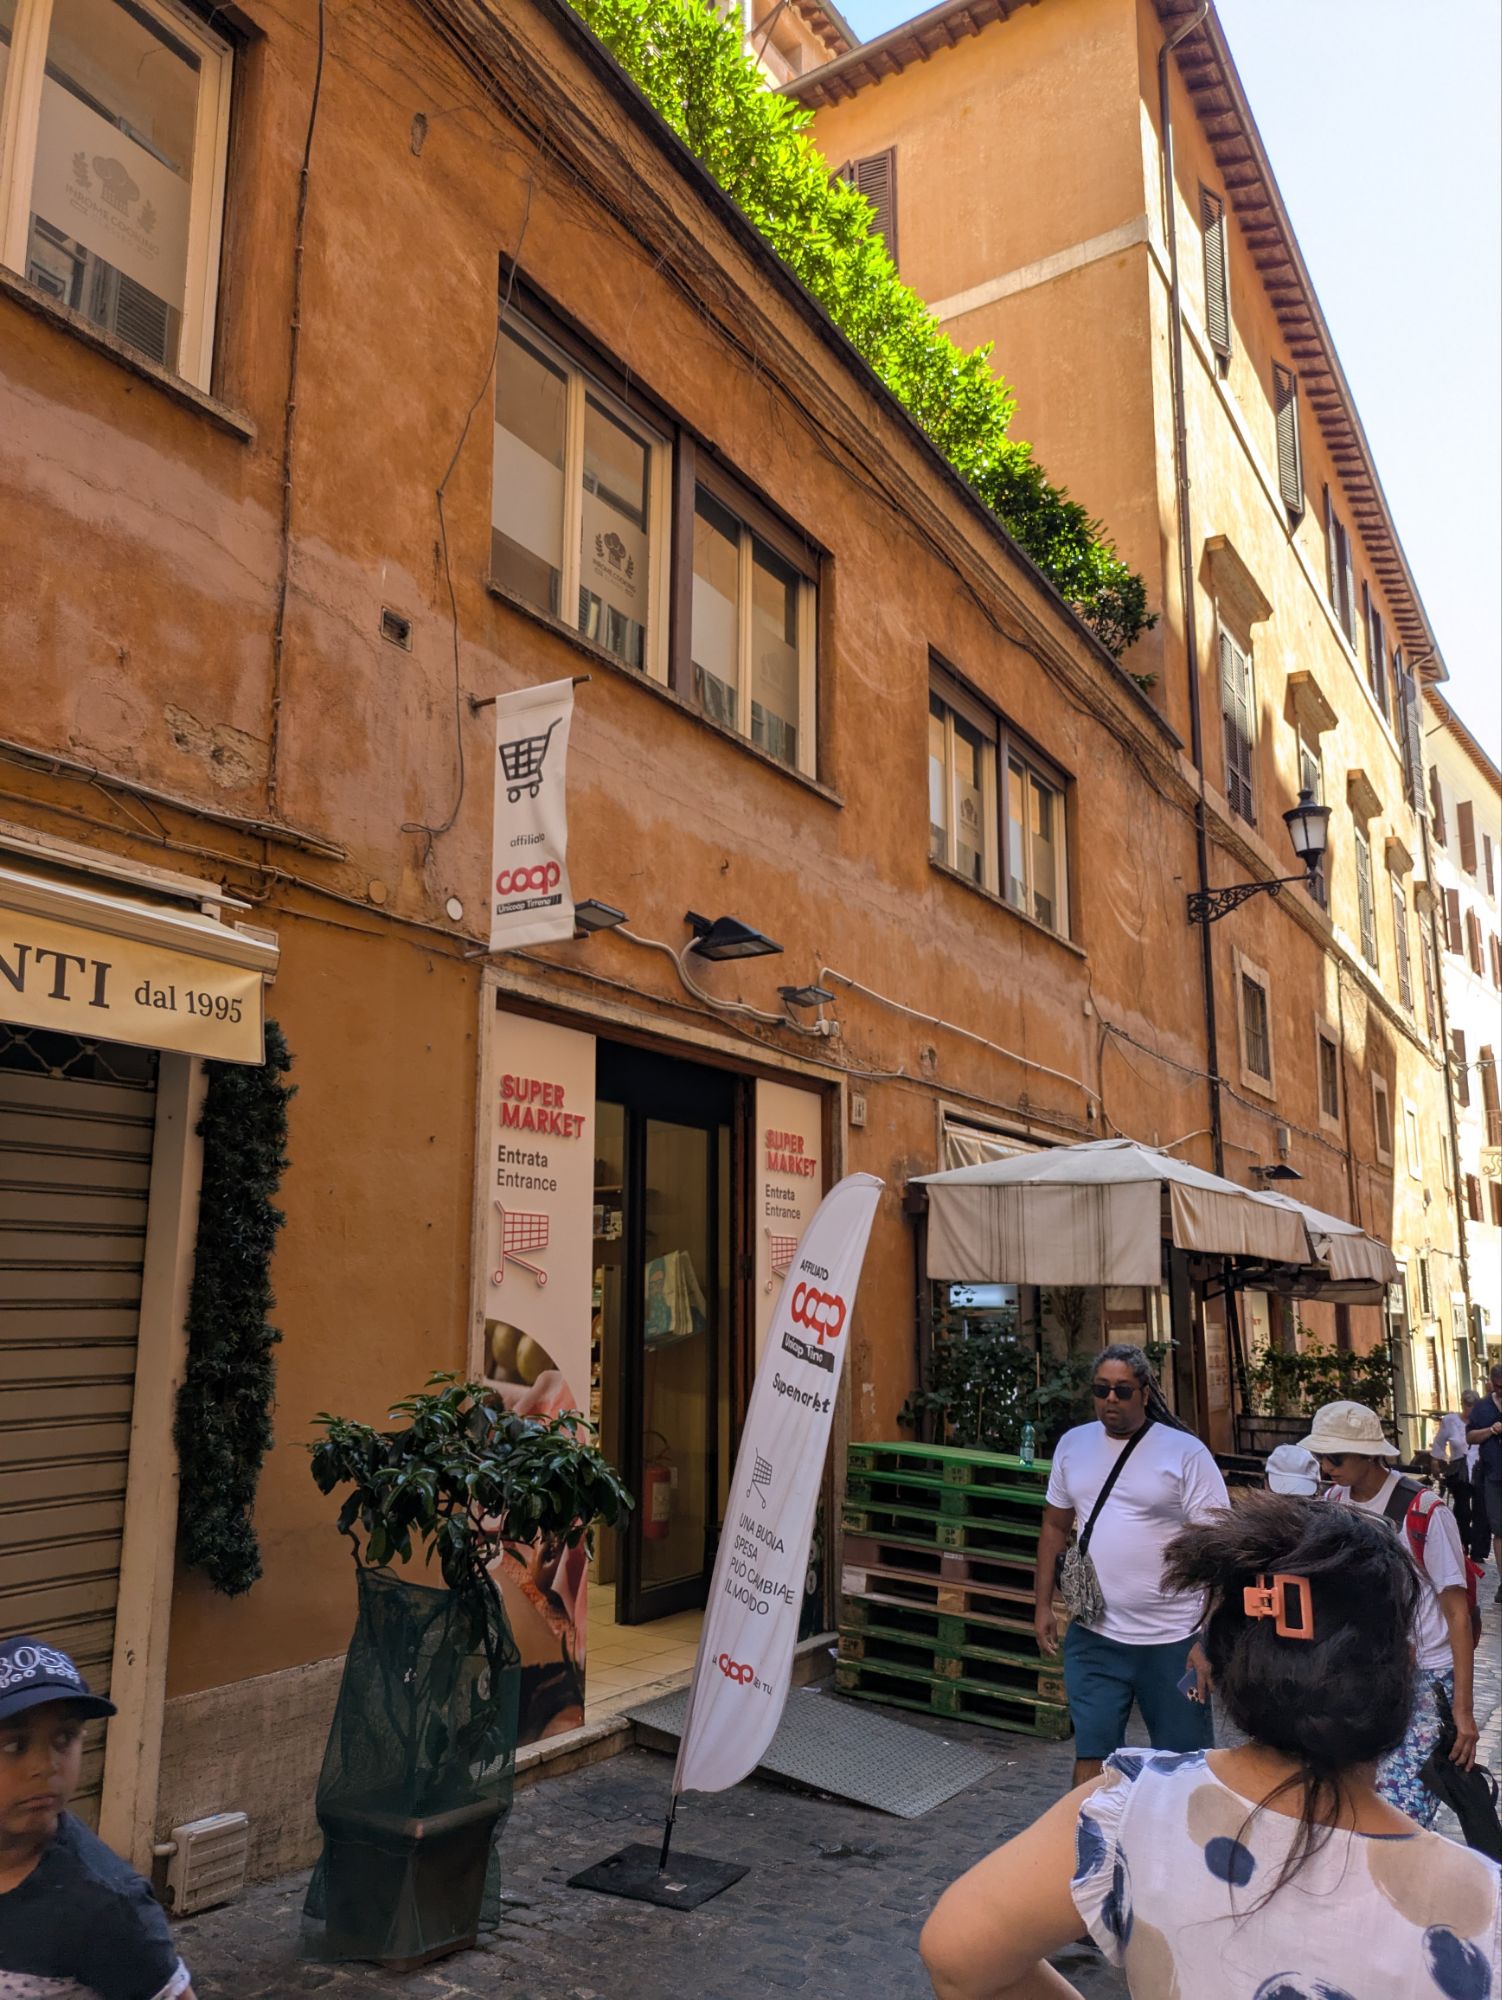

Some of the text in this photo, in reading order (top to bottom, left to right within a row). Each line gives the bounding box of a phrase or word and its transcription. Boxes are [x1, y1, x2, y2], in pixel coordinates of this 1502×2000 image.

[496, 861, 561, 896] coop
[498, 902, 525, 913] Unicoop
[134, 980, 178, 1011] dal
[185, 991, 243, 1023] 1995
[500, 1074, 565, 1109] SUPER
[500, 1102, 586, 1140] MARKET
[766, 1129, 804, 1154] SUPER
[498, 1145, 548, 1168] Entrata
[766, 1151, 816, 1178] MARKET
[497, 1168, 557, 1192] Entrance
[765, 1184, 795, 1201] Entrata
[765, 1202, 800, 1220] Entrance
[791, 1282, 846, 1345] coop
[740, 1512, 755, 1535] UNA
[735, 1534, 757, 1562] SPESA
[725, 1578, 769, 1615] IL MODO
[748, 1569, 795, 1605] CAMBIAE
[763, 1682, 773, 1696] TU
